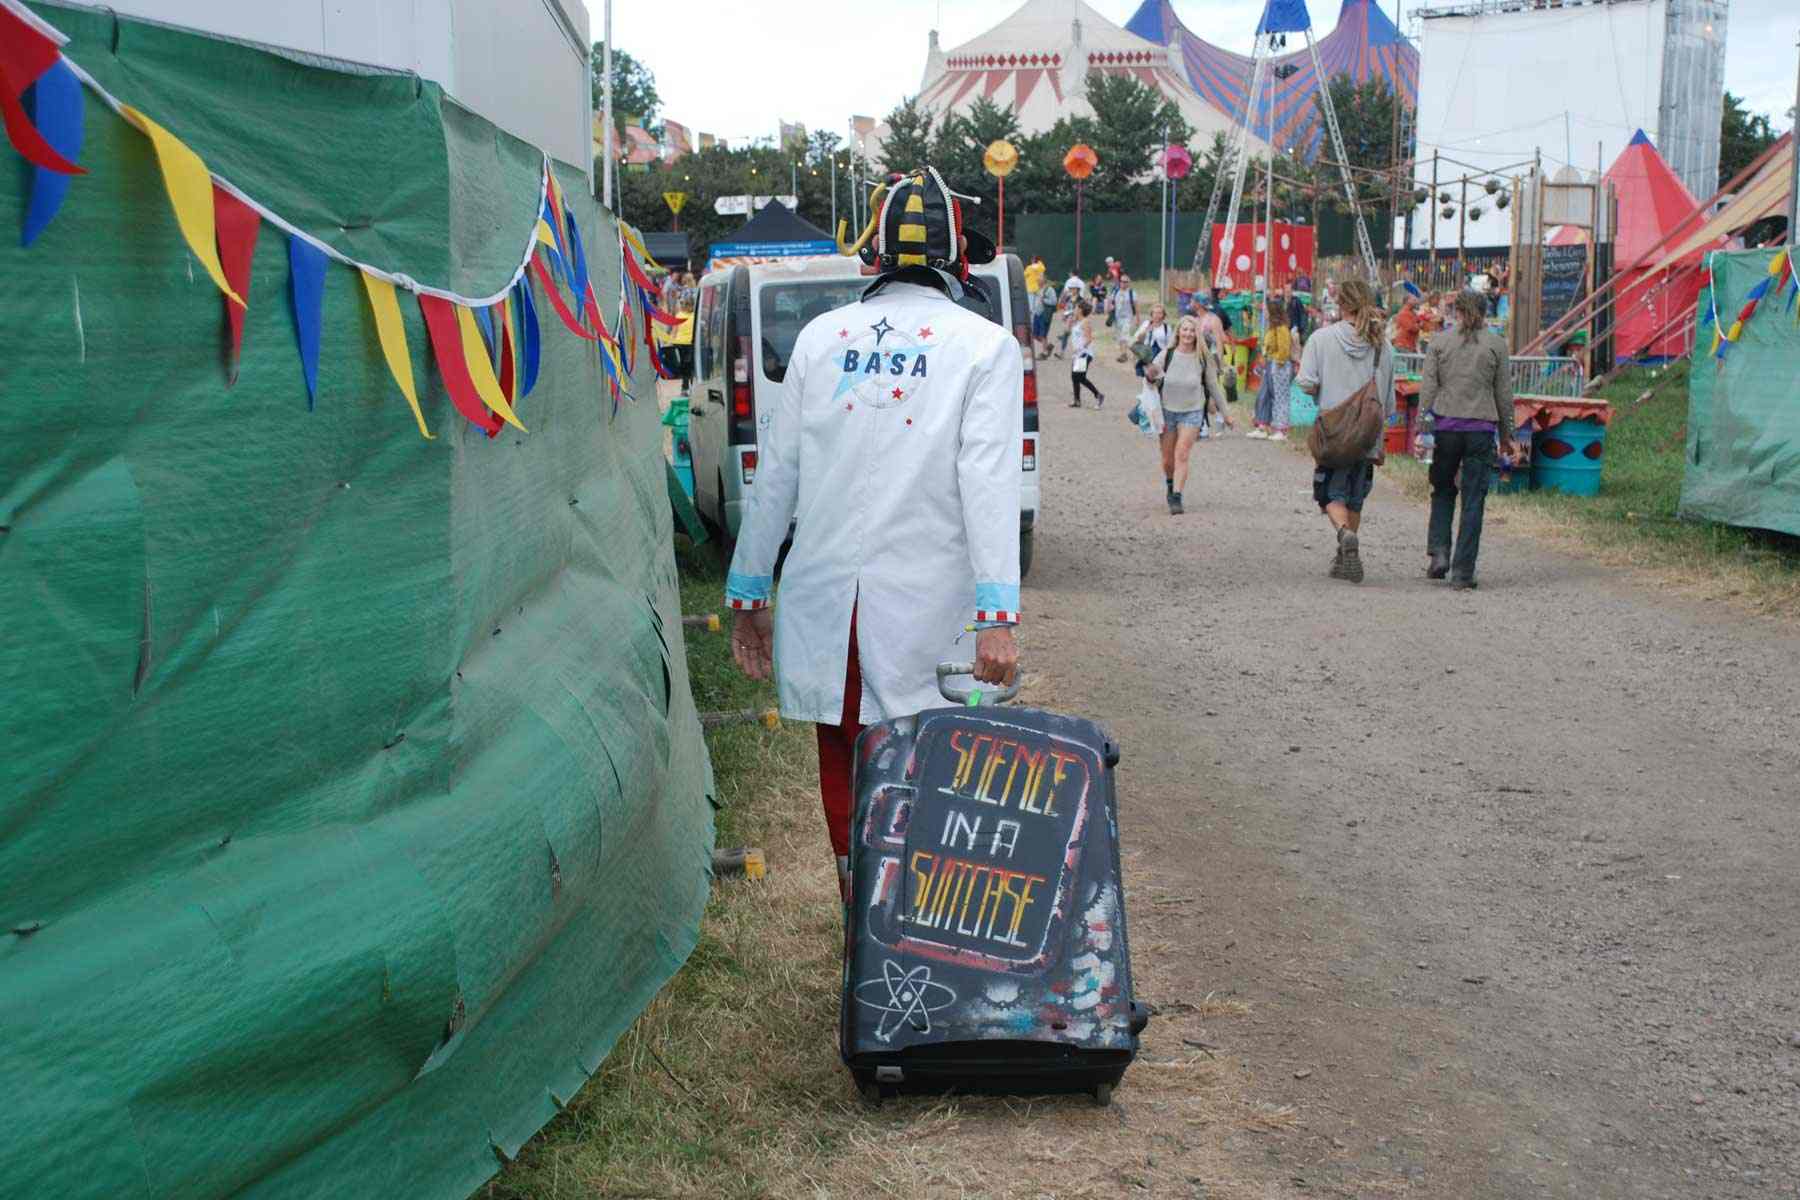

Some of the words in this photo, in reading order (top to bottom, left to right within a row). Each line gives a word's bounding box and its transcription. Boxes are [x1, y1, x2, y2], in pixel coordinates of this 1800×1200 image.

[843, 349, 927, 378] BASA
[937, 729, 1080, 817] SCIENCE
[940, 810, 982, 850] IN
[990, 819, 1021, 858] A
[897, 851, 1046, 947] SUITCASE
